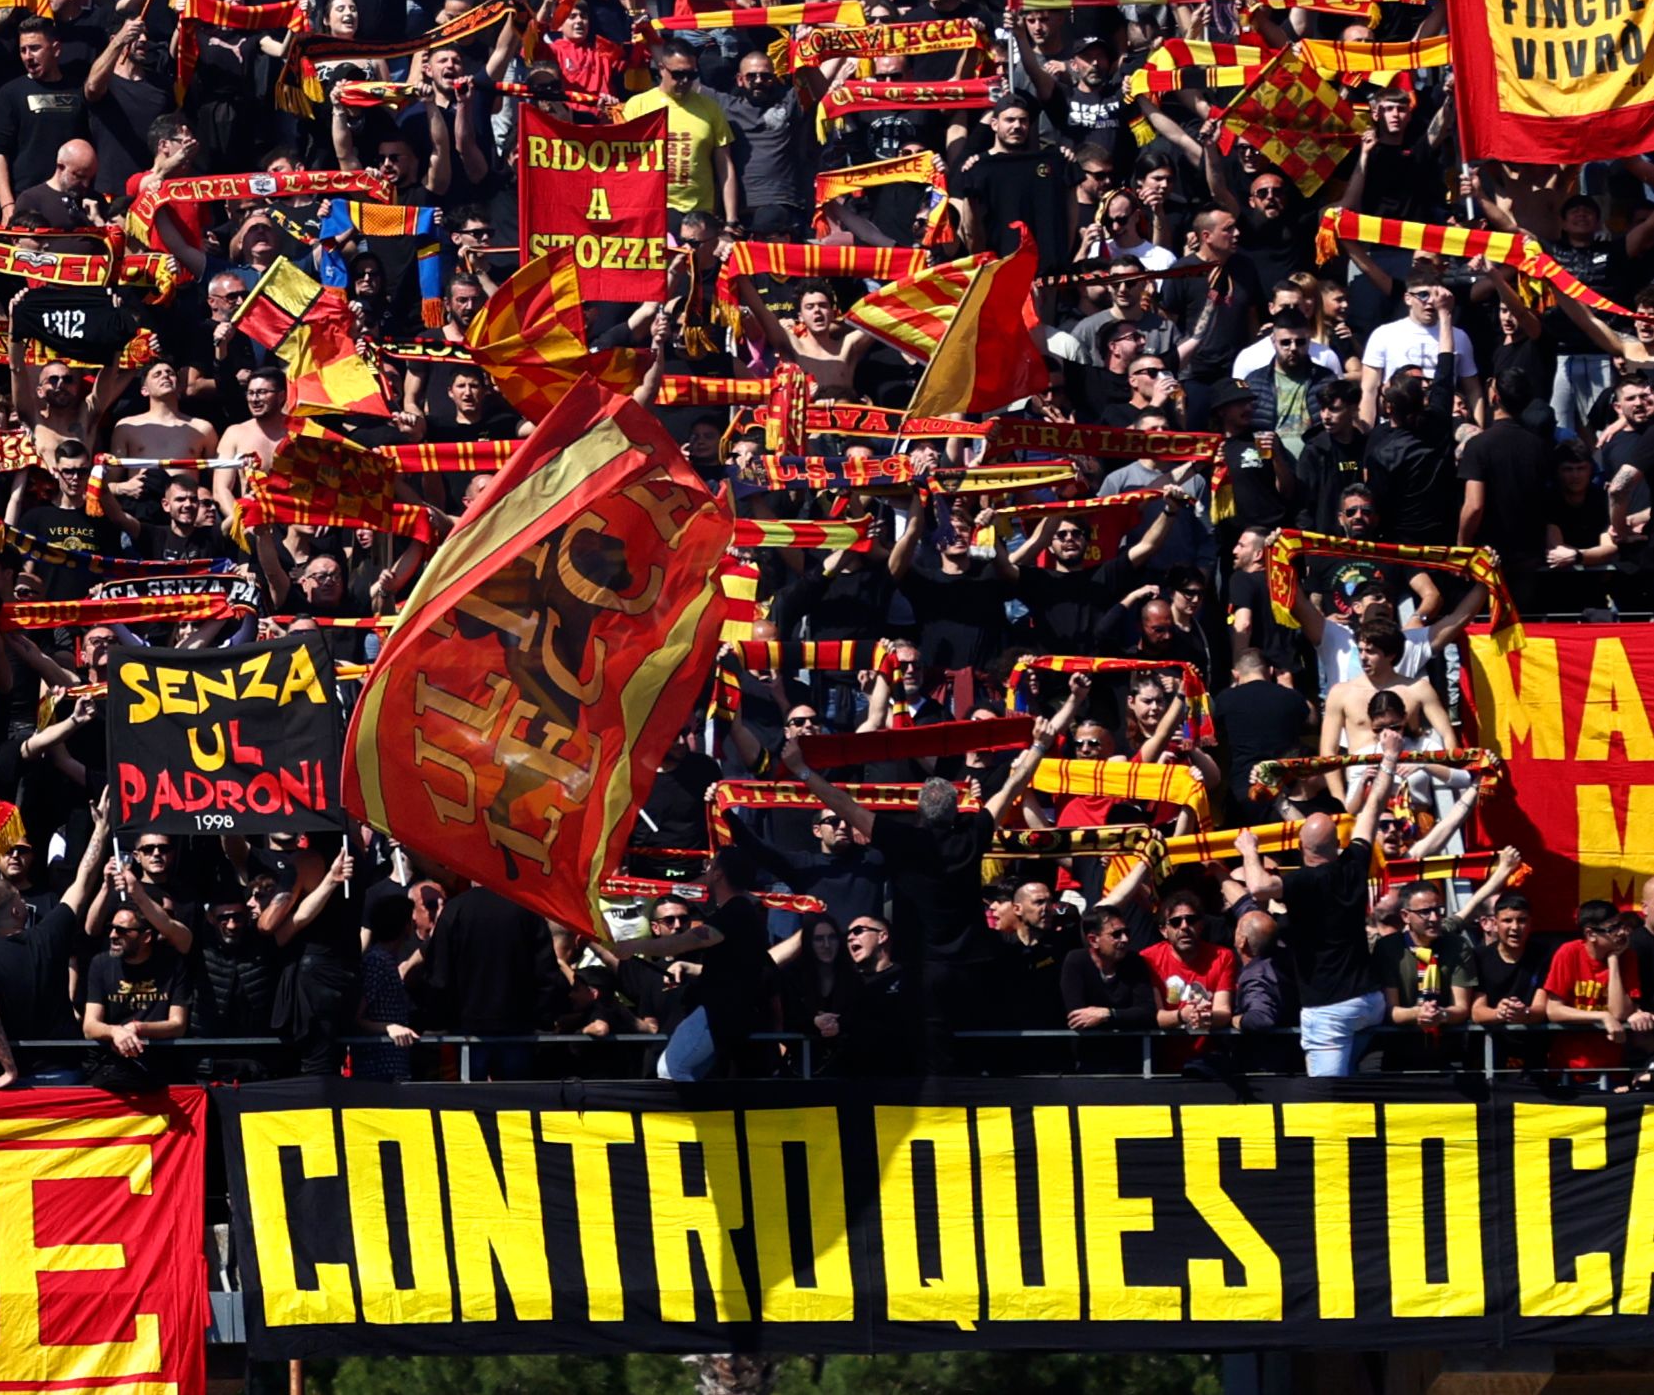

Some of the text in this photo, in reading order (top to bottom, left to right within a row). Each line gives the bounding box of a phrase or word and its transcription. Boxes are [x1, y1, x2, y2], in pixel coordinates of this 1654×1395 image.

[1510, 24, 1645, 82] VIVRÒ
[528, 134, 667, 173] RIDOTTI
[585, 187, 613, 222] A
[528, 234, 668, 271] STOZZE
[41, 310, 86, 338] 1312
[1099, 430, 1221, 458] LECCE
[772, 458, 836, 483] U.S.
[49, 527, 95, 538] VERSACE
[147, 579, 226, 596] SENZA
[118, 646, 328, 725] SENZA
[1467, 636, 1654, 762] MA
[187, 719, 266, 772] UL
[117, 759, 328, 822] PADRONI
[193, 815, 235, 832] 1998
[240, 1102, 856, 1328] CONTRO
[873, 1101, 1486, 1332] QUESTO
